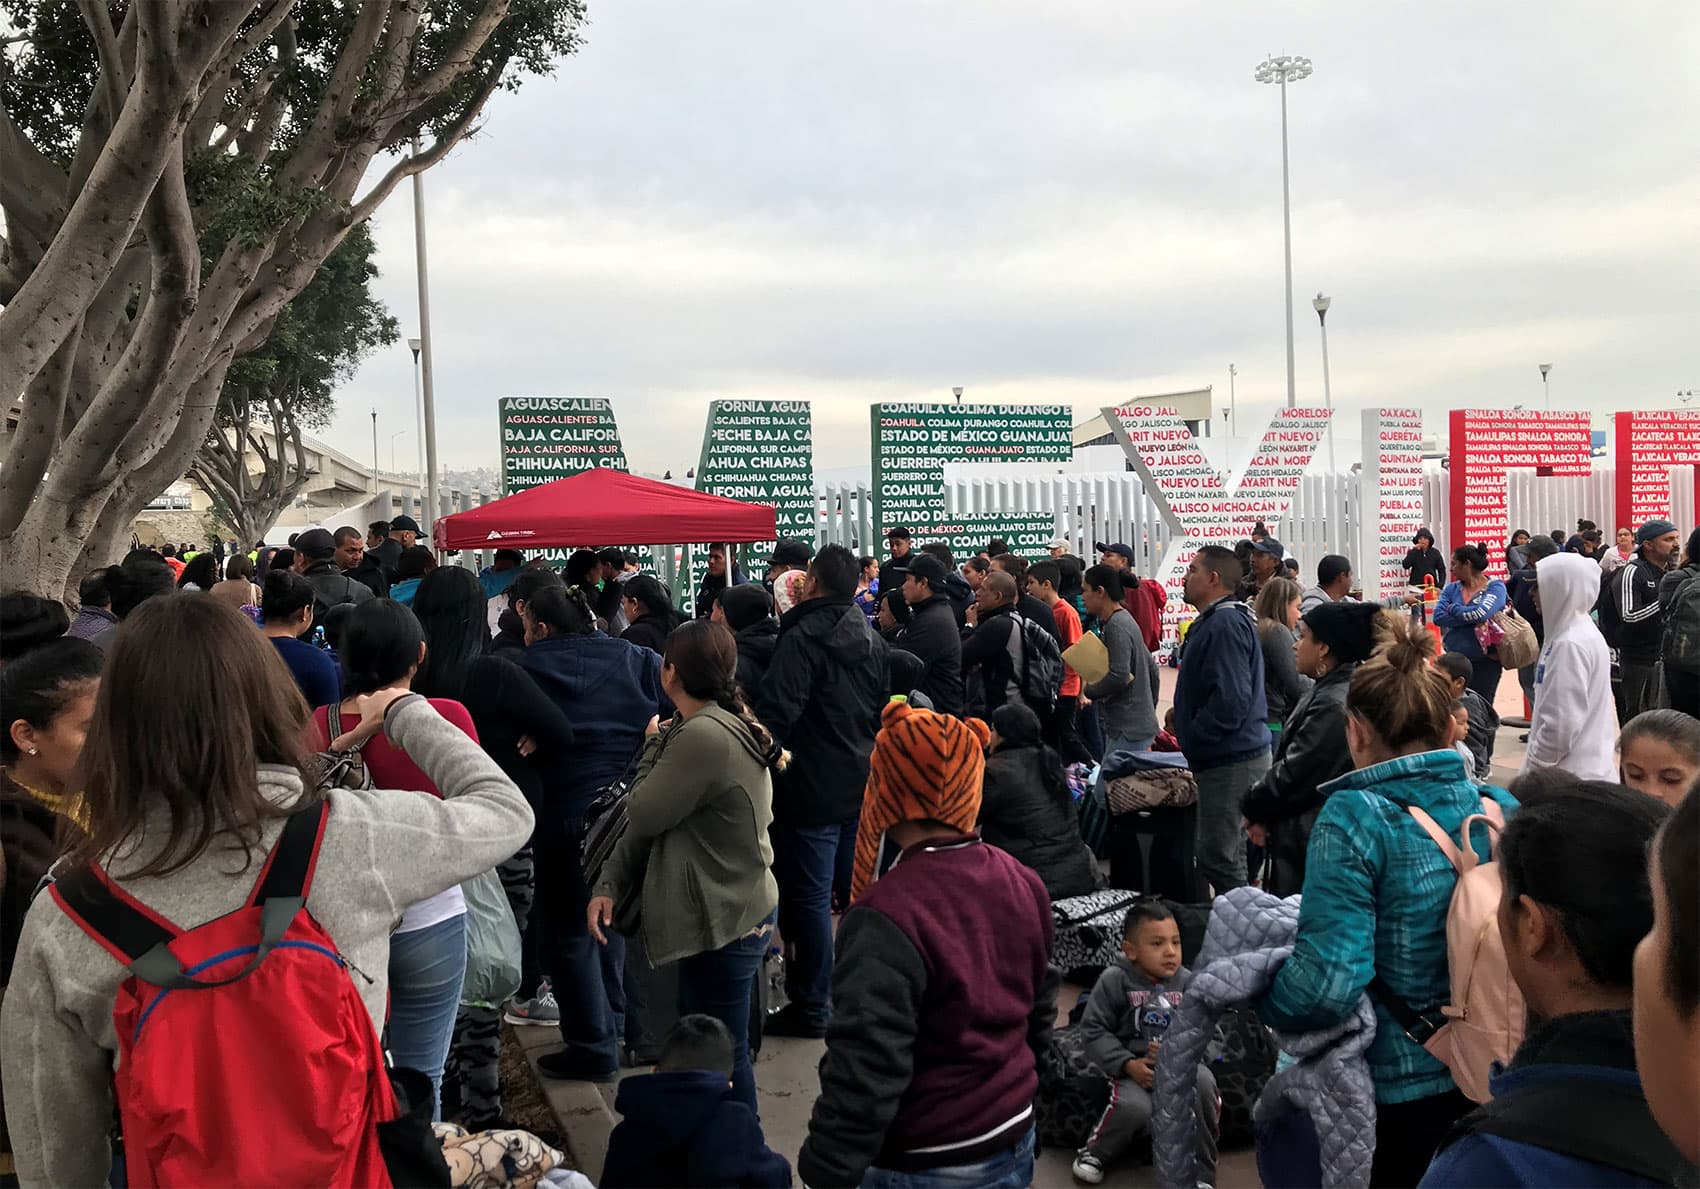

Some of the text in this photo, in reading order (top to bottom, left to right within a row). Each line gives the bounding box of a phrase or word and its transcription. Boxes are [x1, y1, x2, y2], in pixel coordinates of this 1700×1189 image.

[881, 404, 1060, 415] COAHUILA COLIMA DURANGO
[1282, 409, 1328, 418] MORELOS
[1380, 409, 1417, 417] OAXACA
[1465, 410, 1576, 420] SINALOA SONORA TABASCO
[1632, 411, 1671, 420] TLAXCALA
[506, 416, 598, 424] AGUASCALIENTES
[773, 417, 797, 425] BAJA
[881, 419, 925, 427] COAHUILA
[927, 419, 961, 427] COLIMA
[1010, 420, 1053, 428] COAHUILA
[505, 429, 546, 441] BAJA
[755, 429, 790, 440] BAJA
[881, 430, 929, 441] ESTADO
[932, 431, 948, 441] DE
[951, 427, 998, 441] MÉXICO
[1153, 430, 1190, 440] NUEVO
[1279, 432, 1313, 441] NUEVO
[1465, 432, 1588, 441] TAMAULIPAS SINALOA SONORA
[1632, 432, 1674, 441] ZACATECAS
[534, 445, 596, 454] CALIFORNIA
[598, 445, 618, 453] SUR
[710, 445, 758, 453] ALIFORNIA
[760, 445, 778, 453] SUR
[881, 446, 914, 454] ESTADO
[917, 446, 928, 454] DE
[930, 444, 963, 454] MÉXICO
[965, 446, 1024, 454] GUANAJUATO
[1167, 443, 1187, 451] LEÓN
[1158, 455, 1201, 465] JALISCO
[1250, 454, 1279, 465] ACÁN
[1465, 454, 1576, 463] SINALOA SONORA TABASCO
[1632, 453, 1671, 461] TLAXCALA
[506, 458, 596, 470] CHIHUAHUA
[706, 457, 807, 468] AHUA CHIAPAS
[1162, 478, 1199, 488] NUEVO
[1380, 478, 1416, 486] SAN LUIS
[1380, 501, 1412, 509] PUEBLA
[1465, 497, 1500, 505] SINALOA
[1212, 500, 1275, 512] MICHOACÁN
[882, 511, 949, 522] ESTADO DE
[1232, 514, 1266, 522] MORELOS
[918, 526, 929, 534] DE
[931, 524, 964, 533] MÉXICO
[966, 523, 1025, 532] GUANAJUATO
[1380, 570, 1398, 578] SAN
